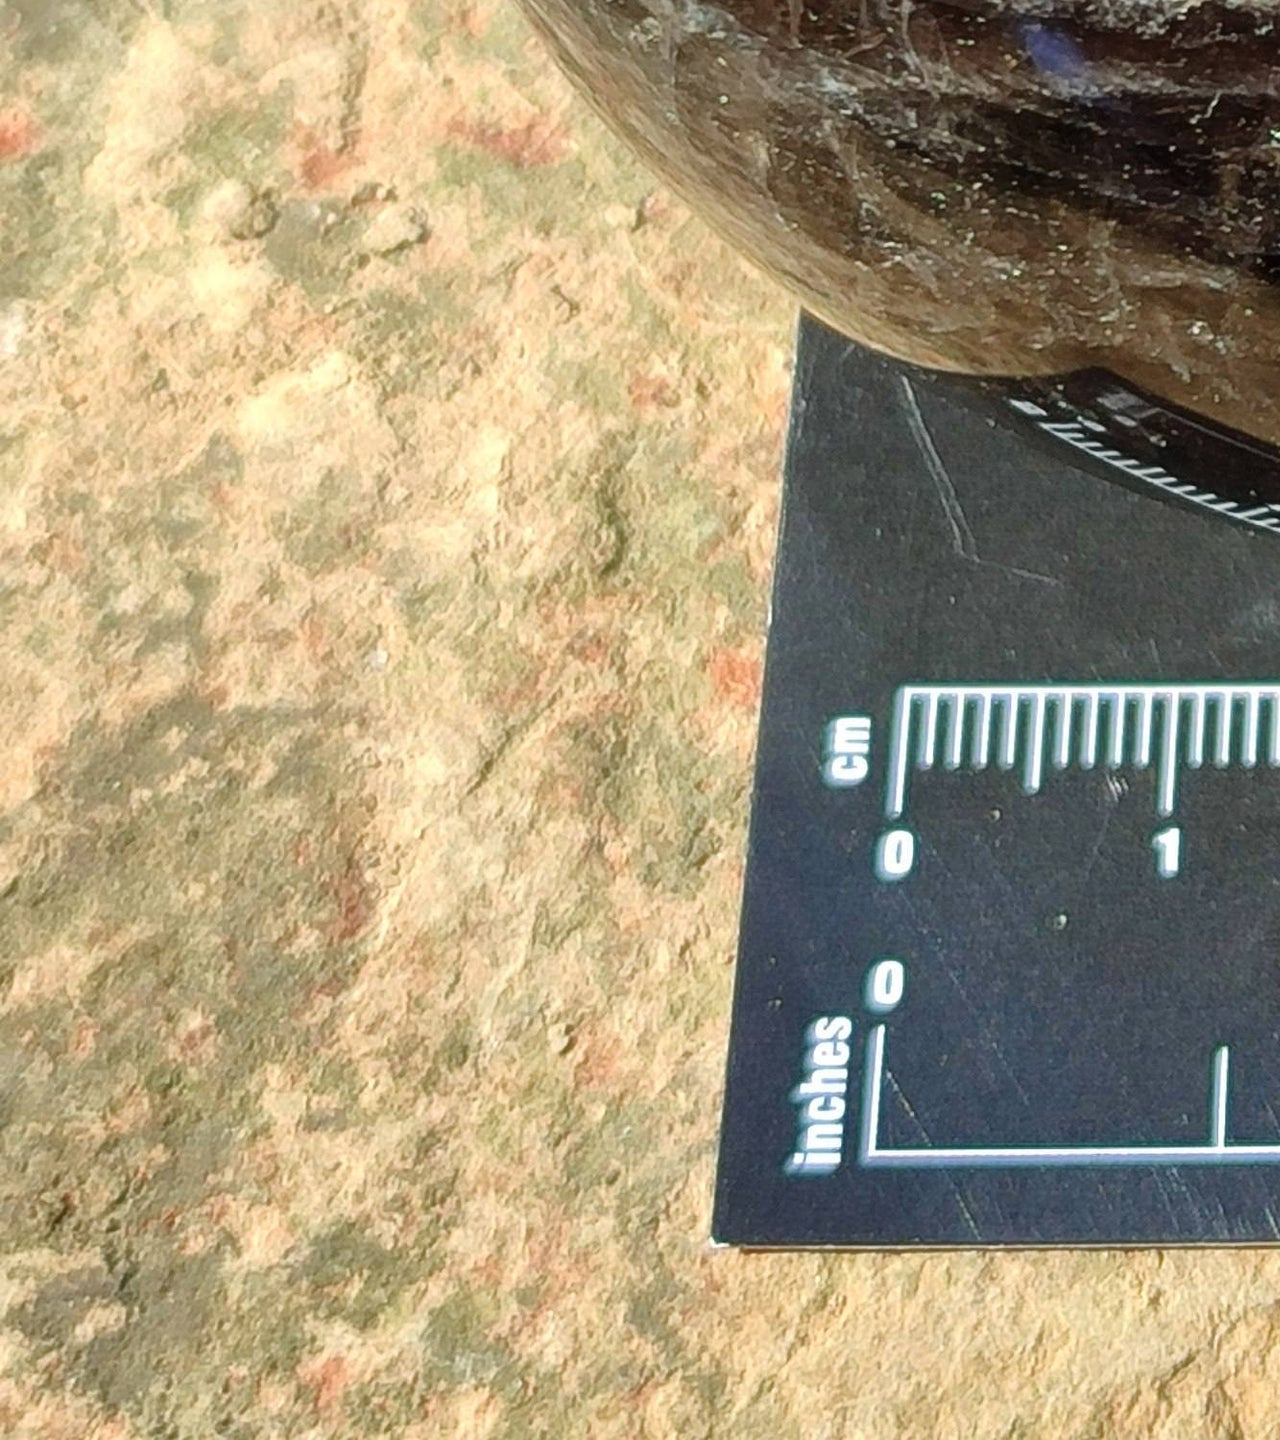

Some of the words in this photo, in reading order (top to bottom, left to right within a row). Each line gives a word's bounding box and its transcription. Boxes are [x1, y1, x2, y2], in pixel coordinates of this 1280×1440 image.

[823, 715, 872, 786] cm
[876, 829, 915, 880] 0
[1152, 827, 1181, 878] 1
[867, 959, 905, 1012] 0
[787, 1014, 853, 1173] inches
